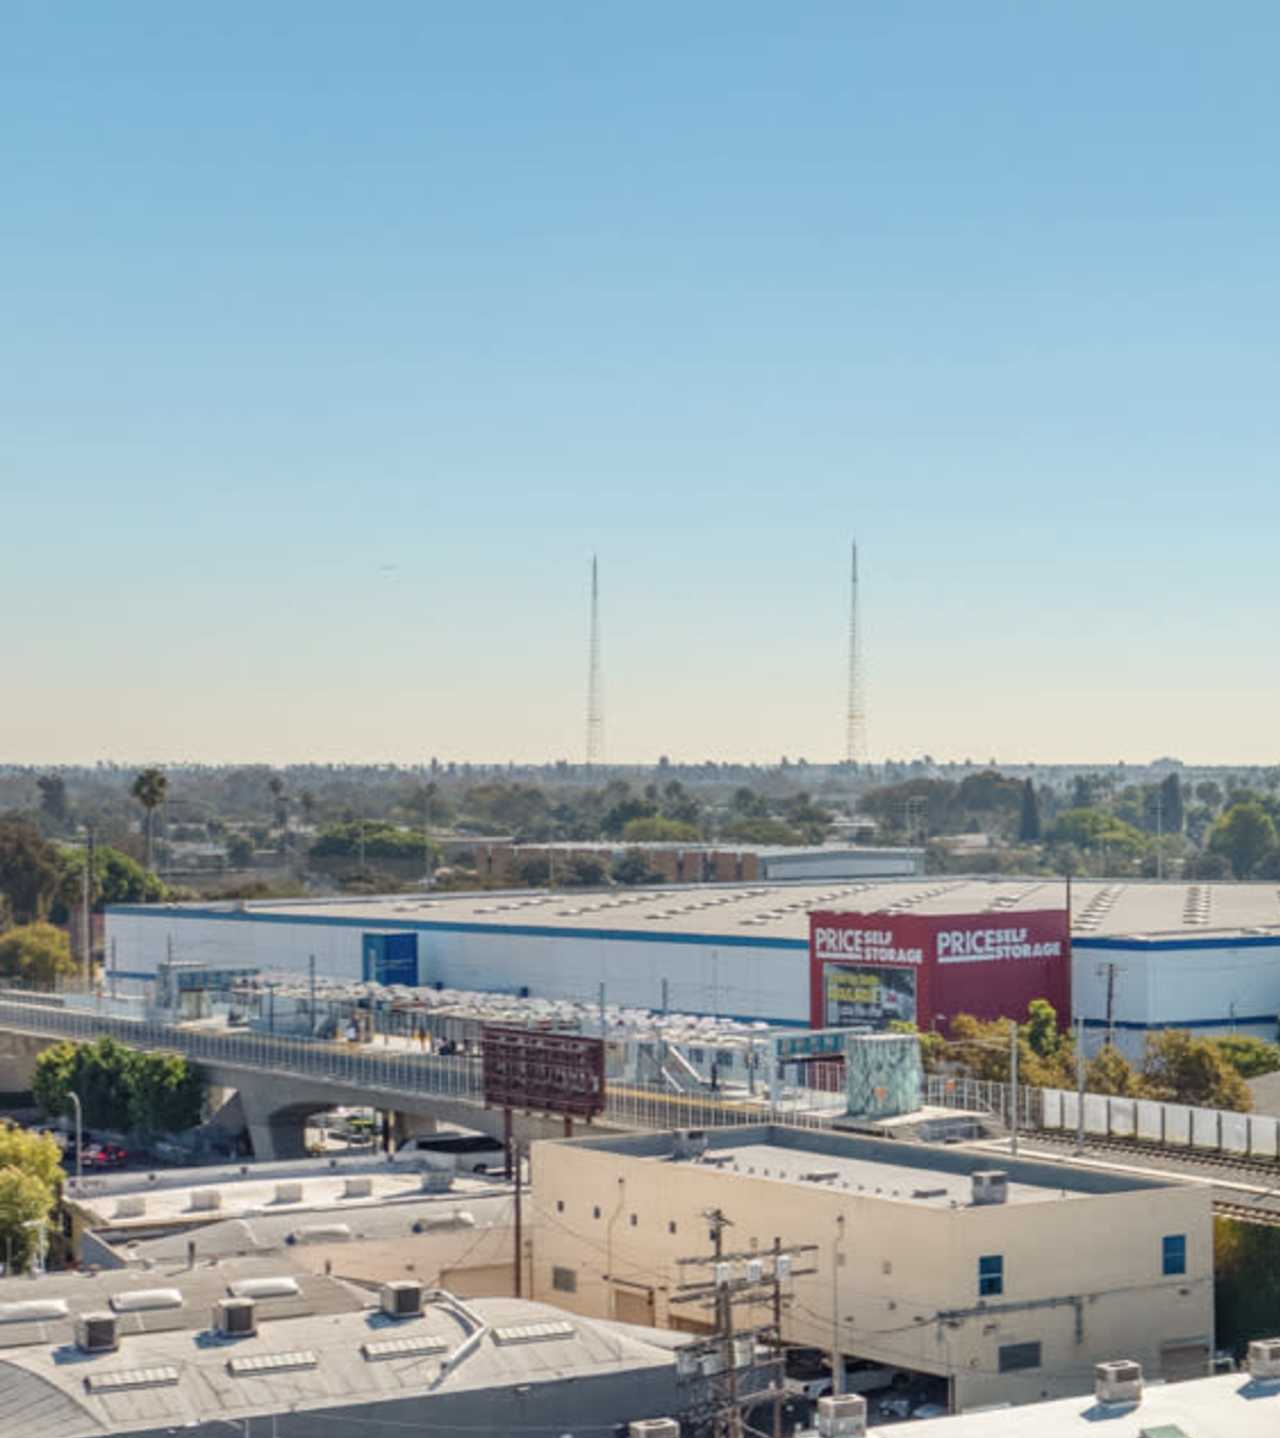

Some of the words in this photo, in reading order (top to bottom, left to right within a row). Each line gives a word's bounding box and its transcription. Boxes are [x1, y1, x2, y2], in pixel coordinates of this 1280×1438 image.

[815, 927, 863, 953] PRICE
[864, 930, 892, 944] SELF
[937, 929, 996, 955] PRICE
[995, 928, 1028, 943] SELF
[995, 942, 1061, 960] STORAGE
[865, 947, 924, 964] STORAGE
